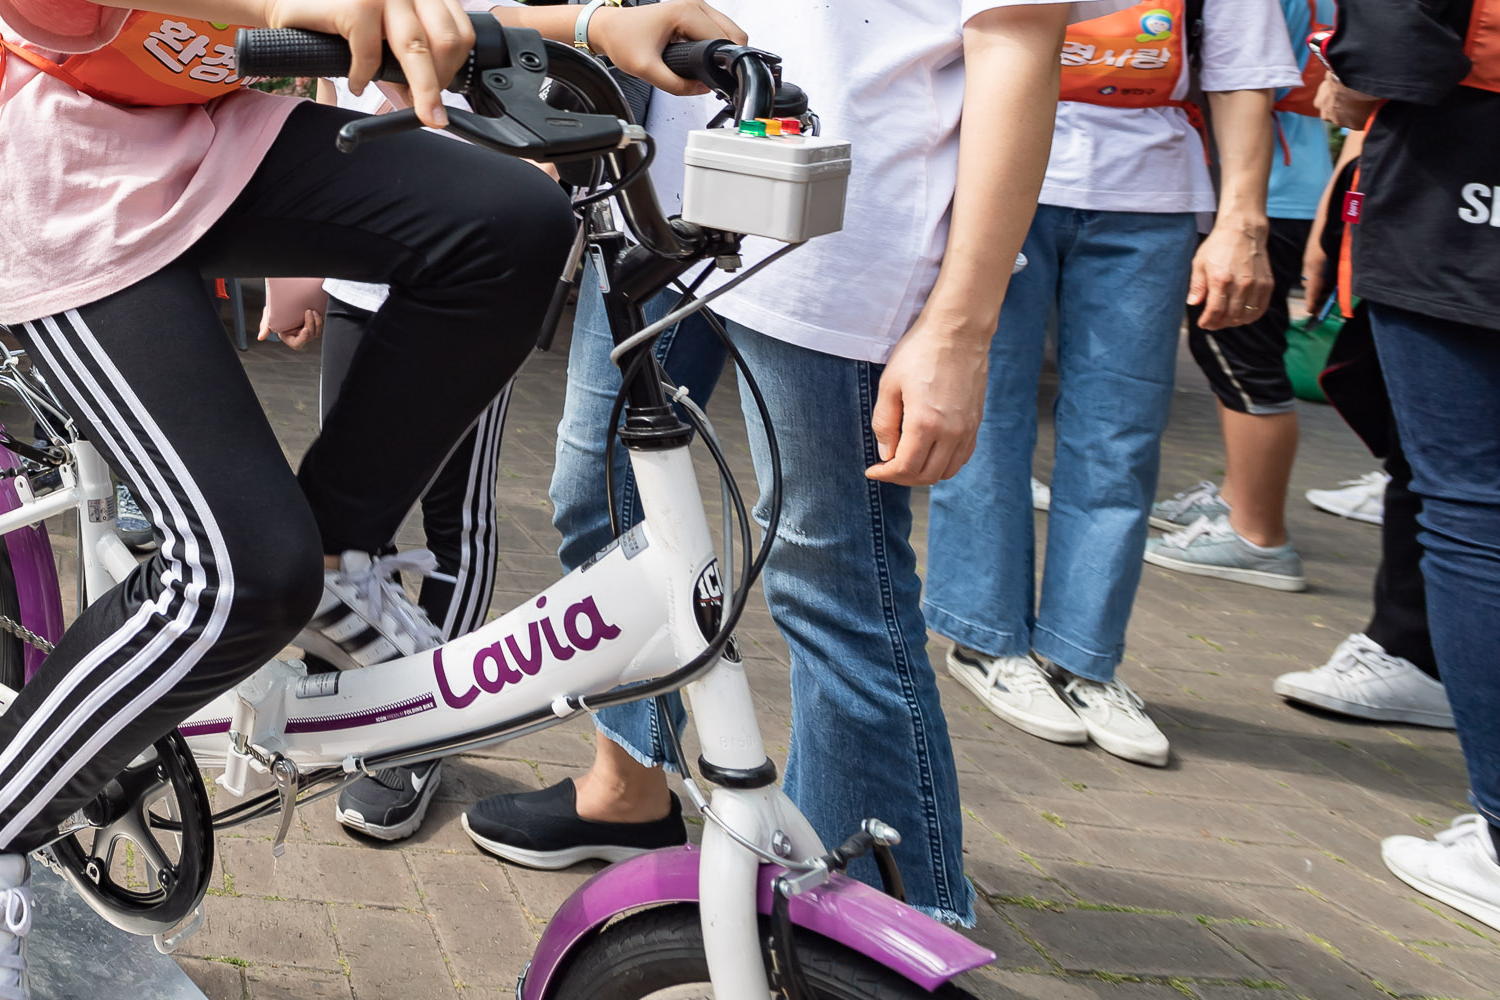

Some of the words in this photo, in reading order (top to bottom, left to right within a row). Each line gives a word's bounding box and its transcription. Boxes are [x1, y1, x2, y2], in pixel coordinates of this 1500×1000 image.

[143, 19, 271, 86] 환경
[433, 595, 622, 709] Lavia
[404, 705, 423, 716] FOLDING
[423, 702, 434, 710] BIKE
